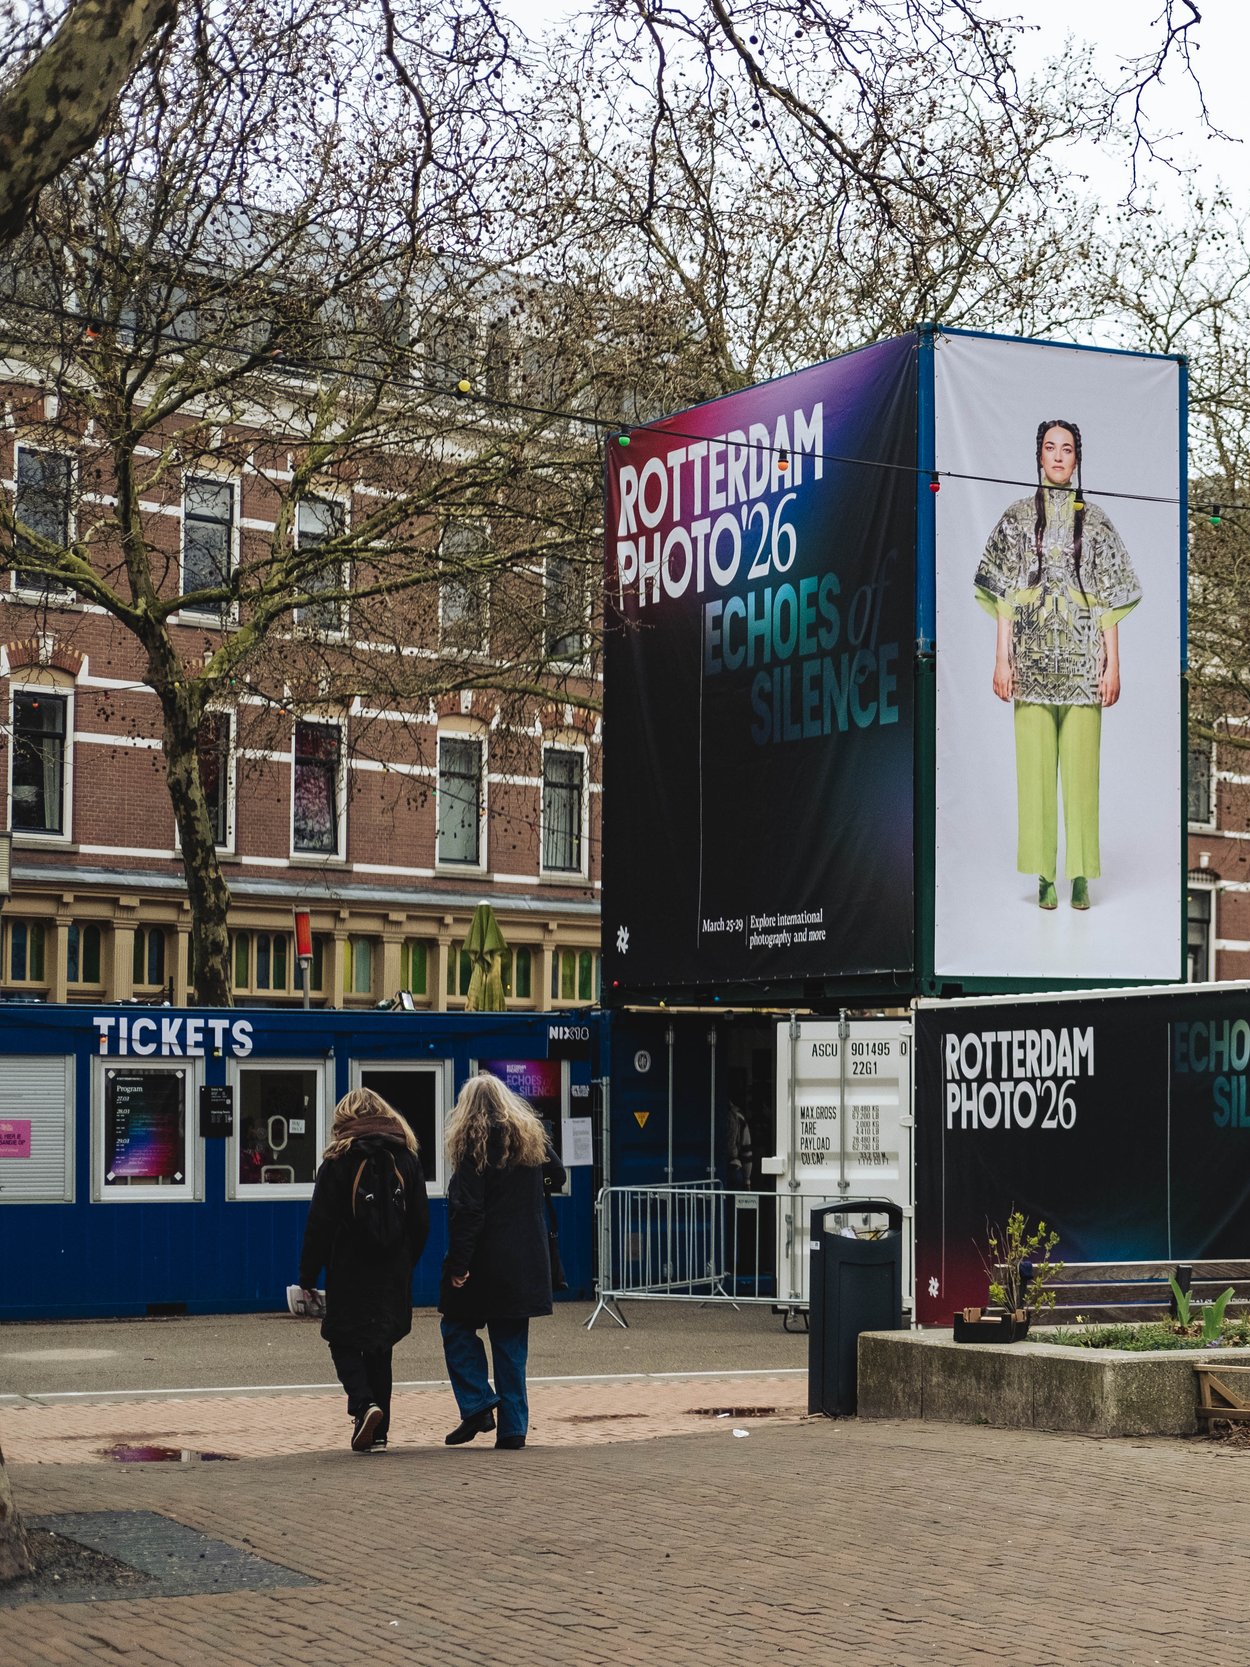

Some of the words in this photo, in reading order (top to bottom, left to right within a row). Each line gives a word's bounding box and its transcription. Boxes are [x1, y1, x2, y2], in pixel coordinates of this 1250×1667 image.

[617, 401, 823, 537] ROTTERDAM
[616, 492, 797, 611] PHOTO'26
[705, 571, 841, 677] ECHOES
[848, 550, 897, 655] of
[751, 641, 899, 746] SILENCE
[702, 917, 725, 932] March
[726, 918, 744, 932] 25-29
[750, 913, 776, 931] Explore
[777, 908, 823, 926] international
[749, 929, 791, 949] photography
[793, 927, 808, 943] and
[808, 929, 826, 941] more
[93, 1017, 254, 1057] TICKETS
[549, 1026, 590, 1040] NIX18
[812, 1043, 838, 1057] ASCU
[851, 1042, 890, 1056] 901495
[900, 1042, 907, 1056] 0
[946, 1026, 1095, 1079] ROTTERDAM
[853, 1061, 878, 1075] 22G1
[507, 1074, 543, 1086] ECHOES
[116, 1085, 143, 1093] Program
[520, 1085, 556, 1097] SILENCE
[946, 1078, 1077, 1129] PHOTO'26
[800, 1106, 837, 1120] MAX.GROSS
[801, 1122, 817, 1135] TARE
[800, 1137, 831, 1151] PAYLOAD
